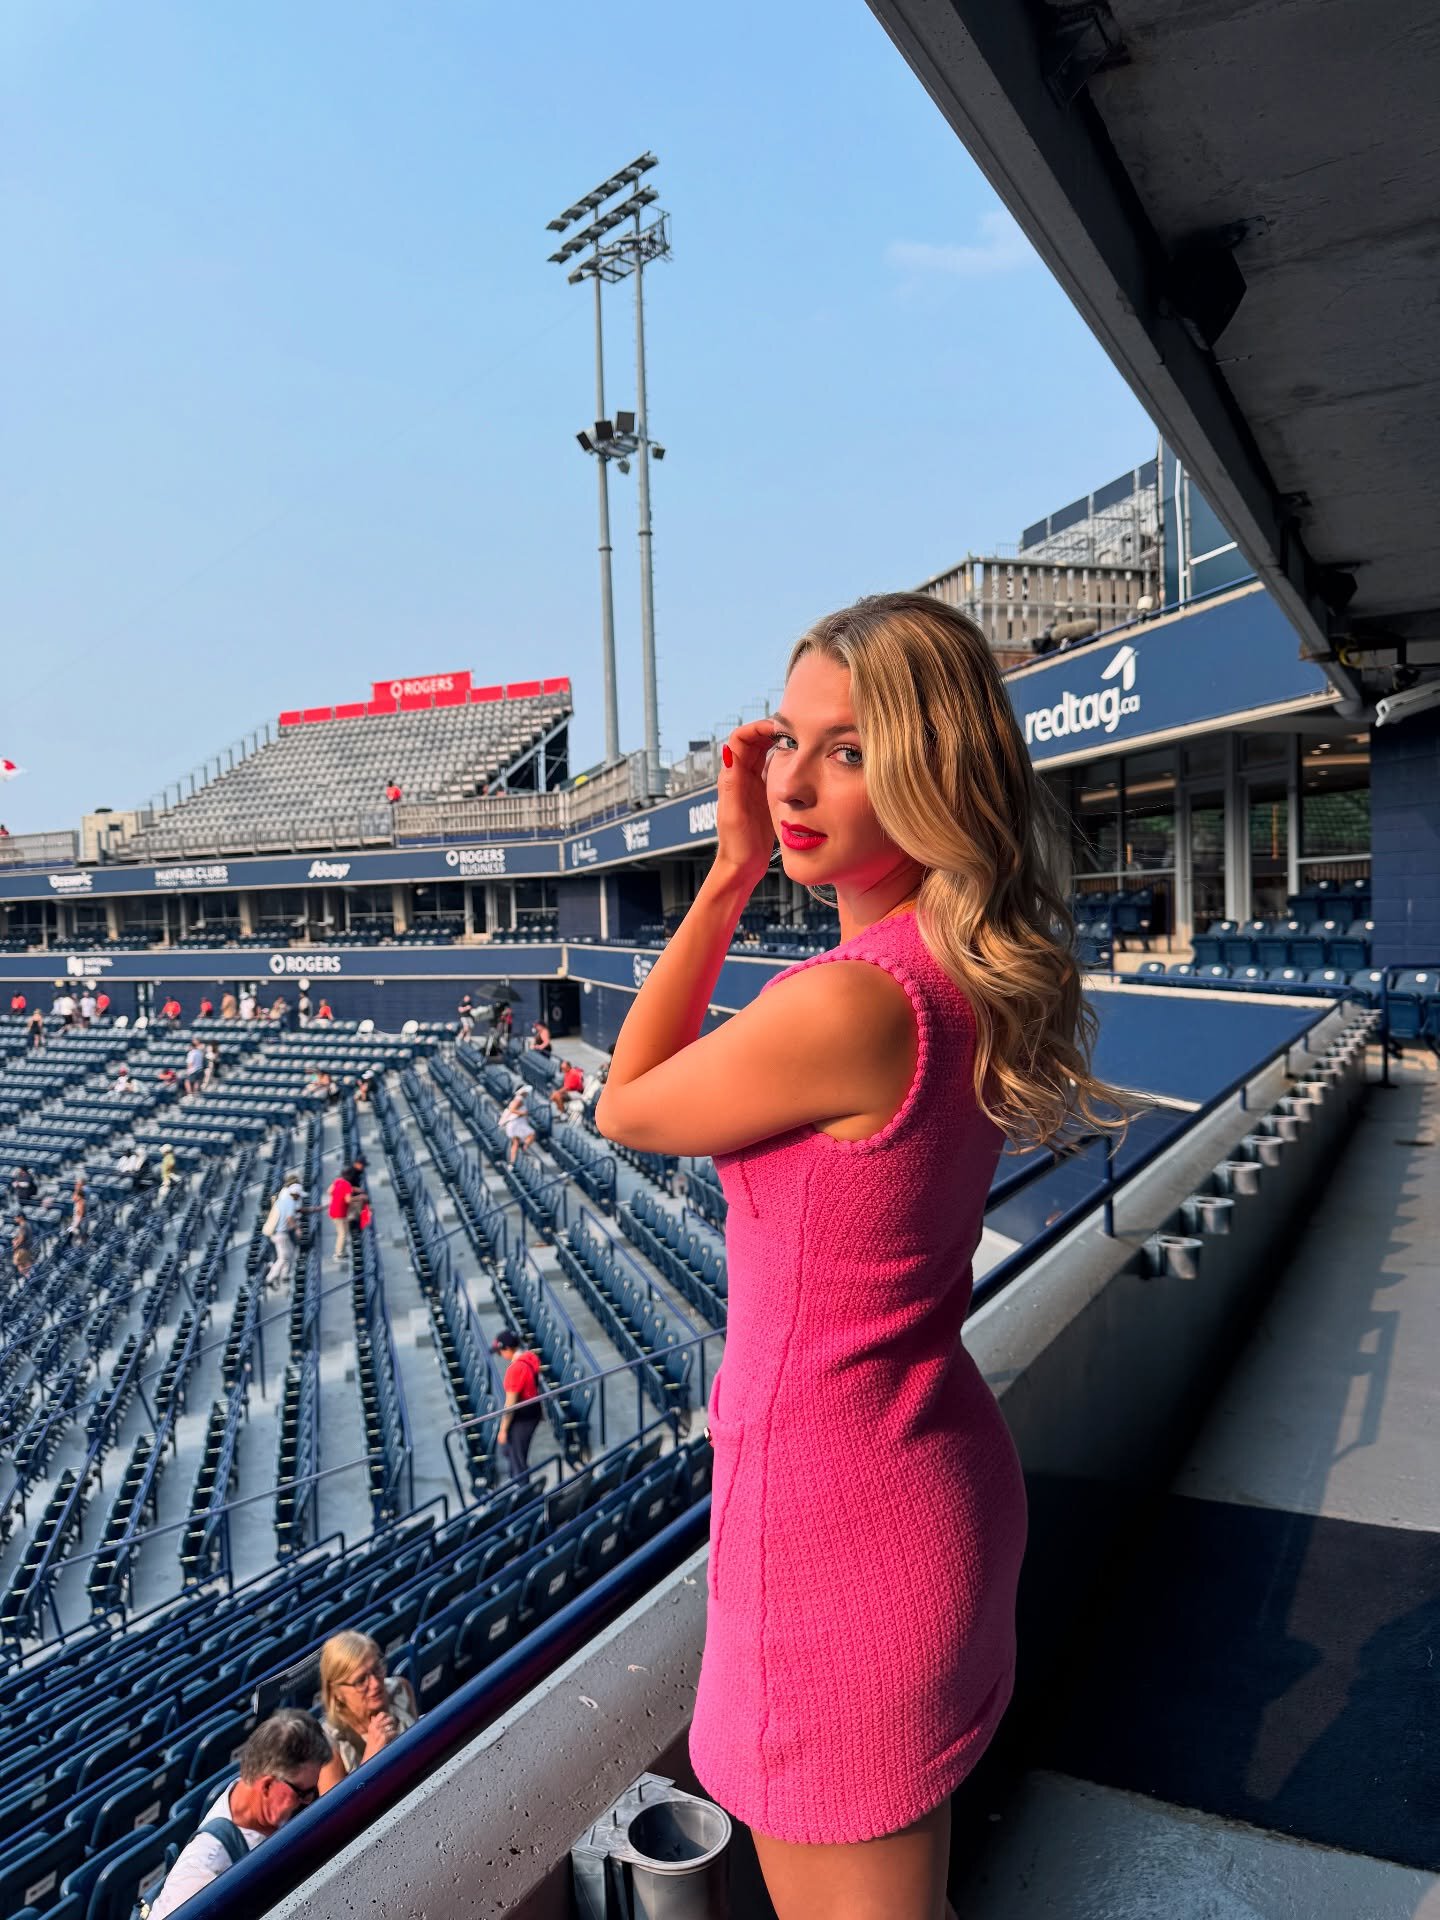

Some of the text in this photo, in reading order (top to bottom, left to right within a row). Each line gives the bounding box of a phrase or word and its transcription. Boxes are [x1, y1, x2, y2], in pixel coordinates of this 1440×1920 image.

[403, 676, 455, 697] ROGERS
[459, 848, 506, 865] ROGERS
[460, 862, 506, 876] BUSINESS
[285, 955, 341, 973] ROGERS
